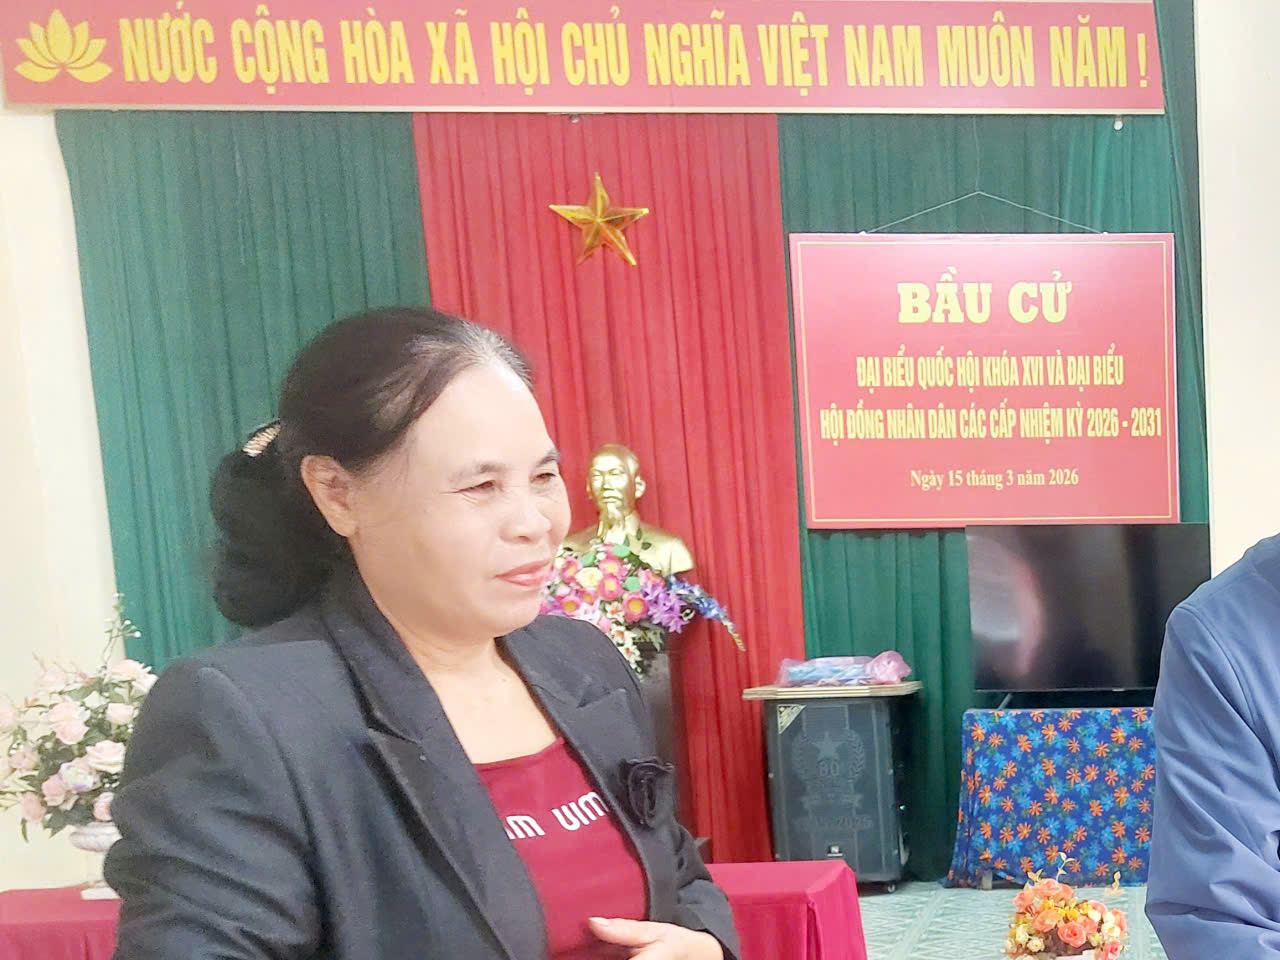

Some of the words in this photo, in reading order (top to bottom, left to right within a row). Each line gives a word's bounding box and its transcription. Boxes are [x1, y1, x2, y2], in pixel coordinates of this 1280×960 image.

[119, 0, 217, 83] NƯỚC
[231, 3, 330, 95] CỘNG
[340, 7, 415, 85] HÒA
[425, 7, 479, 85] XÃ
[490, 8, 551, 96] HỘI
[561, 4, 630, 87] CHỦ
[645, 9, 750, 87] NGHĨA
[757, 11, 829, 96] VIỆT
[844, 25, 924, 87] NAM
[936, 10, 1033, 87] MUÔN
[1049, 14, 1127, 87] NĂM
[897, 266, 992, 323] BẦU
[1008, 270, 1072, 323] CỬ
[856, 356, 880, 393] ĐẠI
[882, 344, 914, 387] BIỂU
[917, 347, 953, 389] QUỐC
[956, 350, 980, 392] HỘI
[983, 351, 1019, 386] KHÓA
[1021, 355, 1044, 386] XVI
[1045, 350, 1065, 385] VÀ
[1067, 355, 1090, 392] ĐẠI
[1093, 343, 1124, 385] BIỂU
[820, 404, 844, 446] HỘI
[886, 405, 925, 438] NHÂN
[928, 404, 957, 438] DÂN
[959, 402, 987, 438] CÁC
[989, 398, 1016, 438] CẤP
[1019, 402, 1063, 444] NHIỆM
[1066, 401, 1083, 437] KỲ
[1086, 411, 1119, 437] 2026
[1131, 407, 1162, 437] 2031
[910, 470, 944, 490] Ngày
[948, 470, 963, 486] 15
[966, 468, 1004, 490] tháng
[1006, 468, 1014, 486] 3
[1017, 469, 1045, 486] năm
[1049, 468, 1079, 485] 2026
